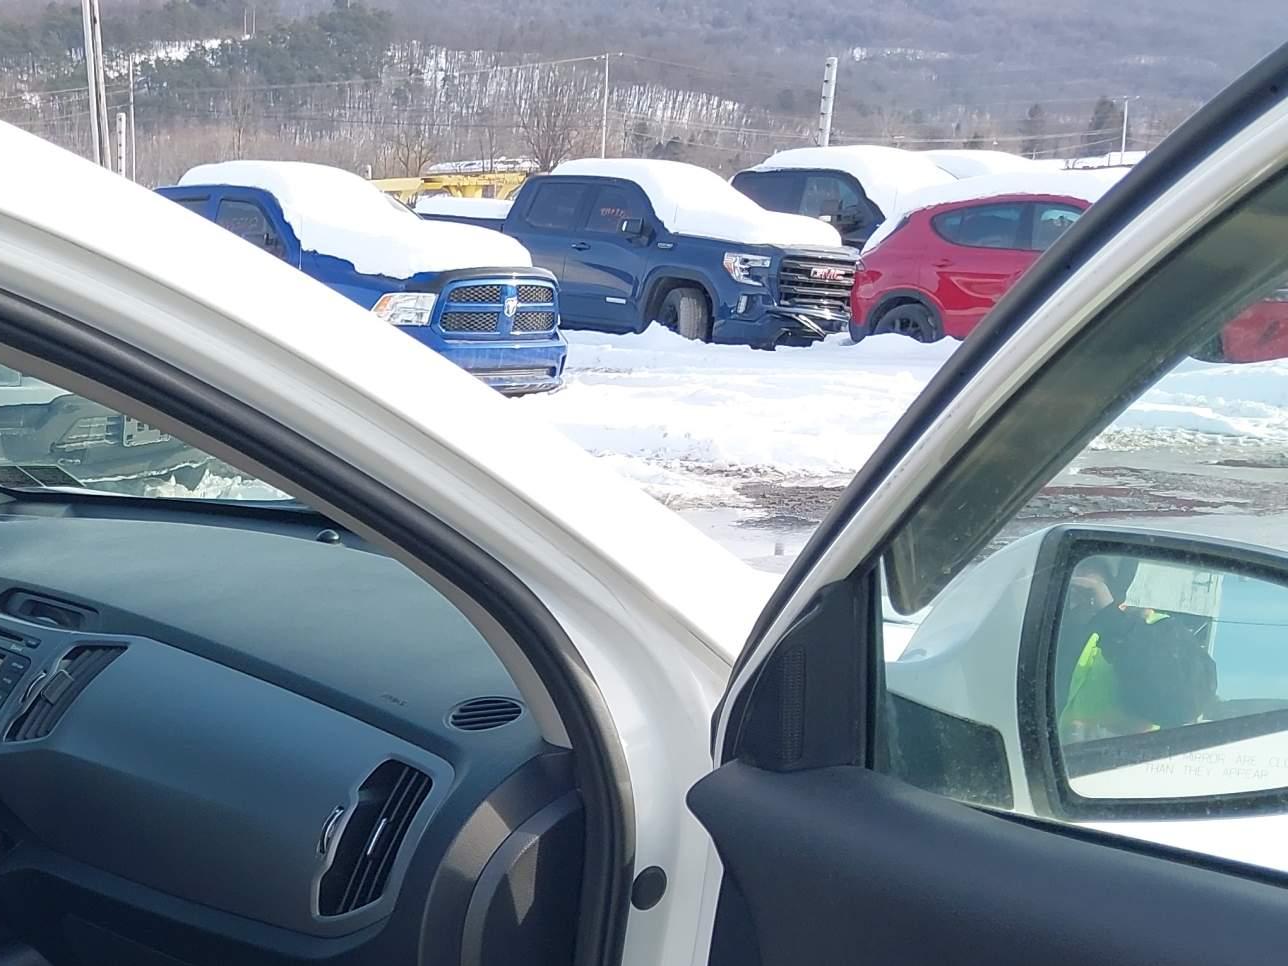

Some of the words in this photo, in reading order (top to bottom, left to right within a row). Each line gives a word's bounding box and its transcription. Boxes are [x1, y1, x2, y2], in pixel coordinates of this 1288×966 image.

[1235, 753, 1257, 767] ARE
[1145, 763, 1174, 776] THAN
[1184, 764, 1211, 776] THEY
[1223, 767, 1269, 780] APPEAR
